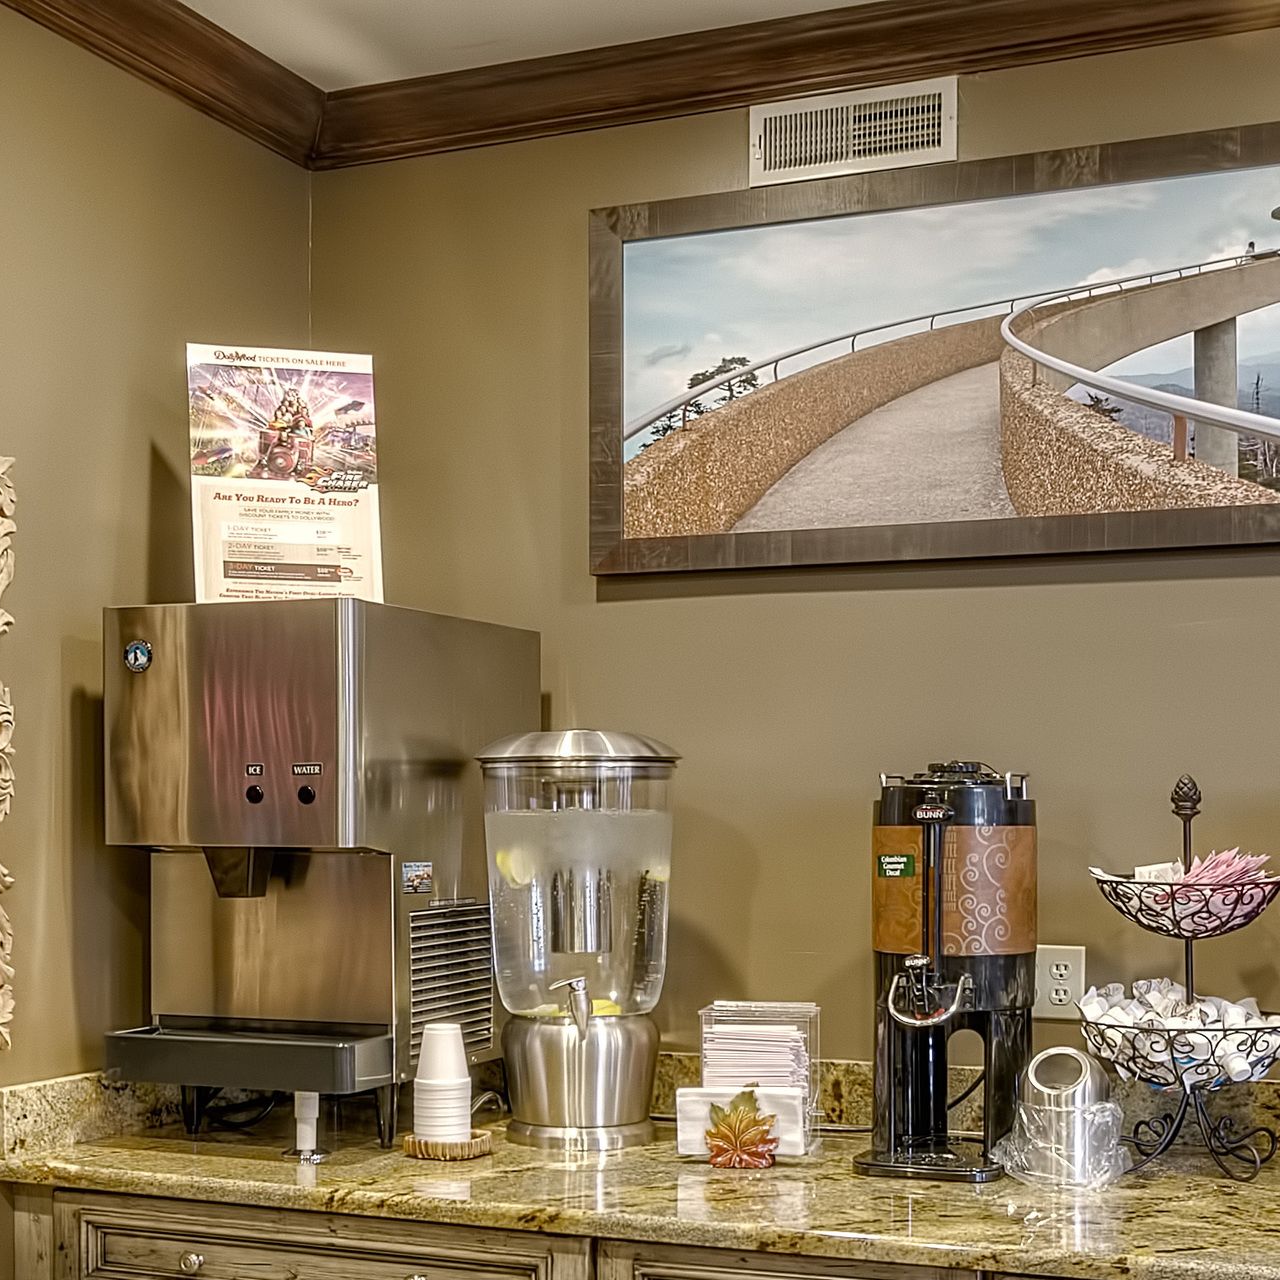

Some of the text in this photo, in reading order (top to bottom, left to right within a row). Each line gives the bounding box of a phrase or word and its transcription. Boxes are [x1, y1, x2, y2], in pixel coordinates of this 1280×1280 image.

[258, 354, 290, 364] TICKETS
[291, 357, 304, 365] ON
[305, 358, 325, 366] SALE
[326, 360, 347, 368] HERE
[248, 766, 261, 774] ICE
[293, 766, 321, 774] WATER
[916, 809, 943, 818] BUNN
